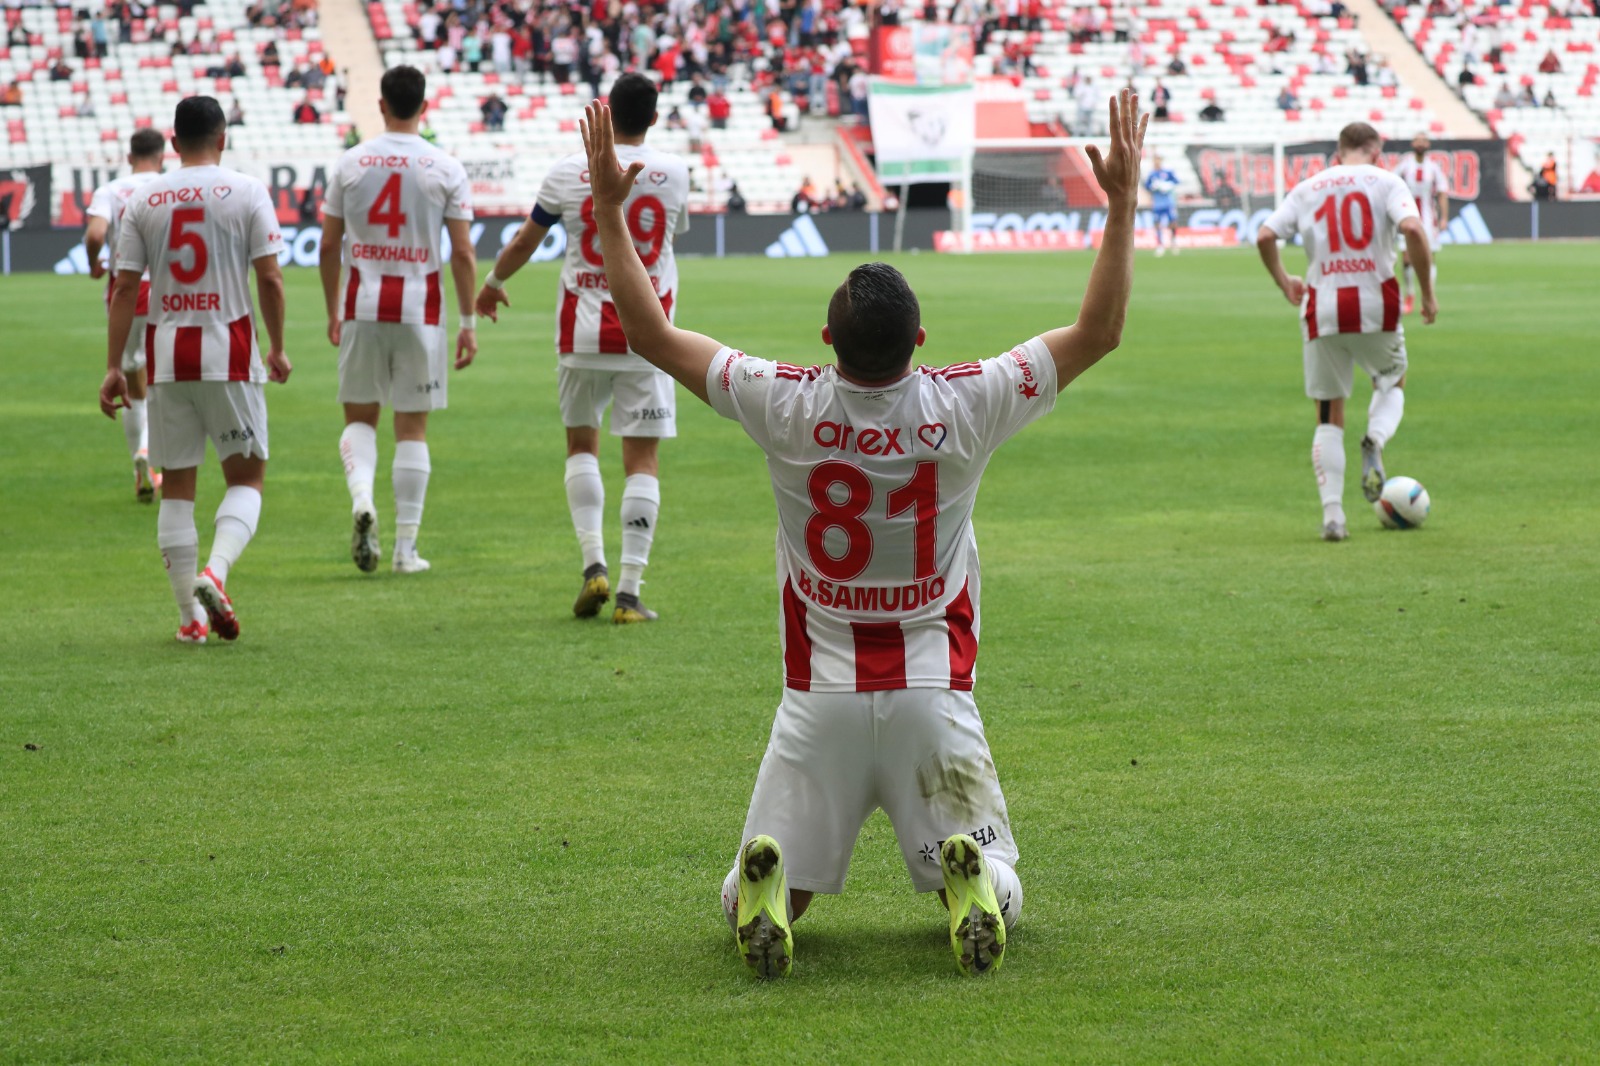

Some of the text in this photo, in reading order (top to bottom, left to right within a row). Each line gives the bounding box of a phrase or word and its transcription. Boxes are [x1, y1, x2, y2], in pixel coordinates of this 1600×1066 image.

[359, 154, 410, 169] anex
[1312, 175, 1356, 192] anex
[148, 186, 204, 208] anex
[367, 172, 407, 238] 4
[1314, 190, 1375, 254] 10
[168, 206, 208, 285] 5
[351, 243, 429, 264] GERXHALIU
[1321, 258, 1376, 276] LARSSON
[162, 293, 221, 312] SONER
[804, 459, 941, 583] 81
[797, 568, 946, 612] B.SAMUDIO
